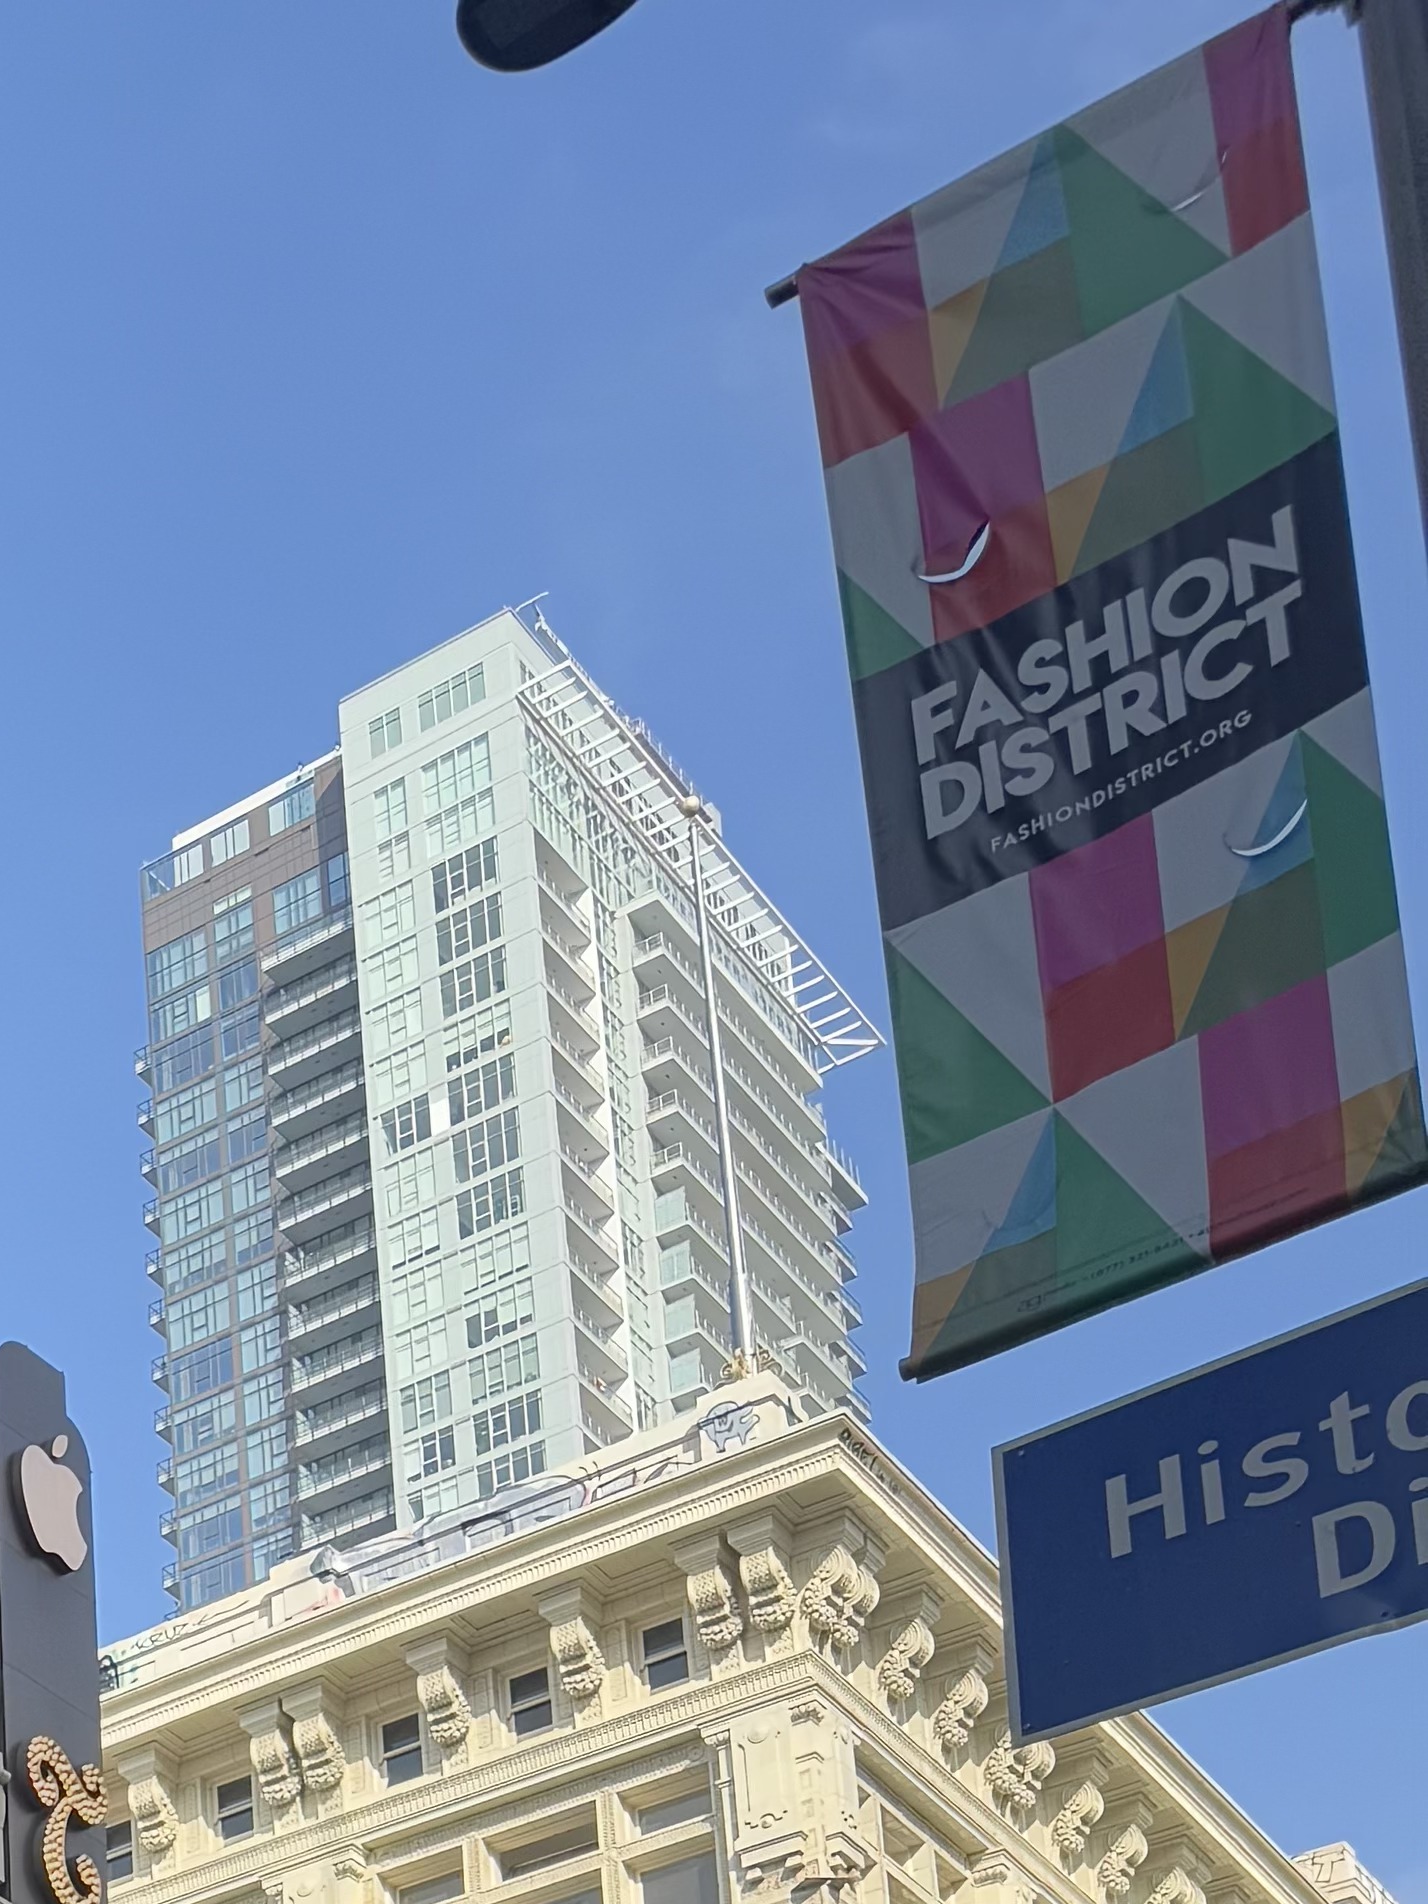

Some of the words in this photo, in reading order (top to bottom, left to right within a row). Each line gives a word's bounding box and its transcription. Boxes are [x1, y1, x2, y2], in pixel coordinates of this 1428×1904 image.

[911, 504, 1300, 767] FASHION
[920, 578, 1303, 841] DISTRICT
[991, 708, 1253, 854] FASHIONDISTRICT.ORG
